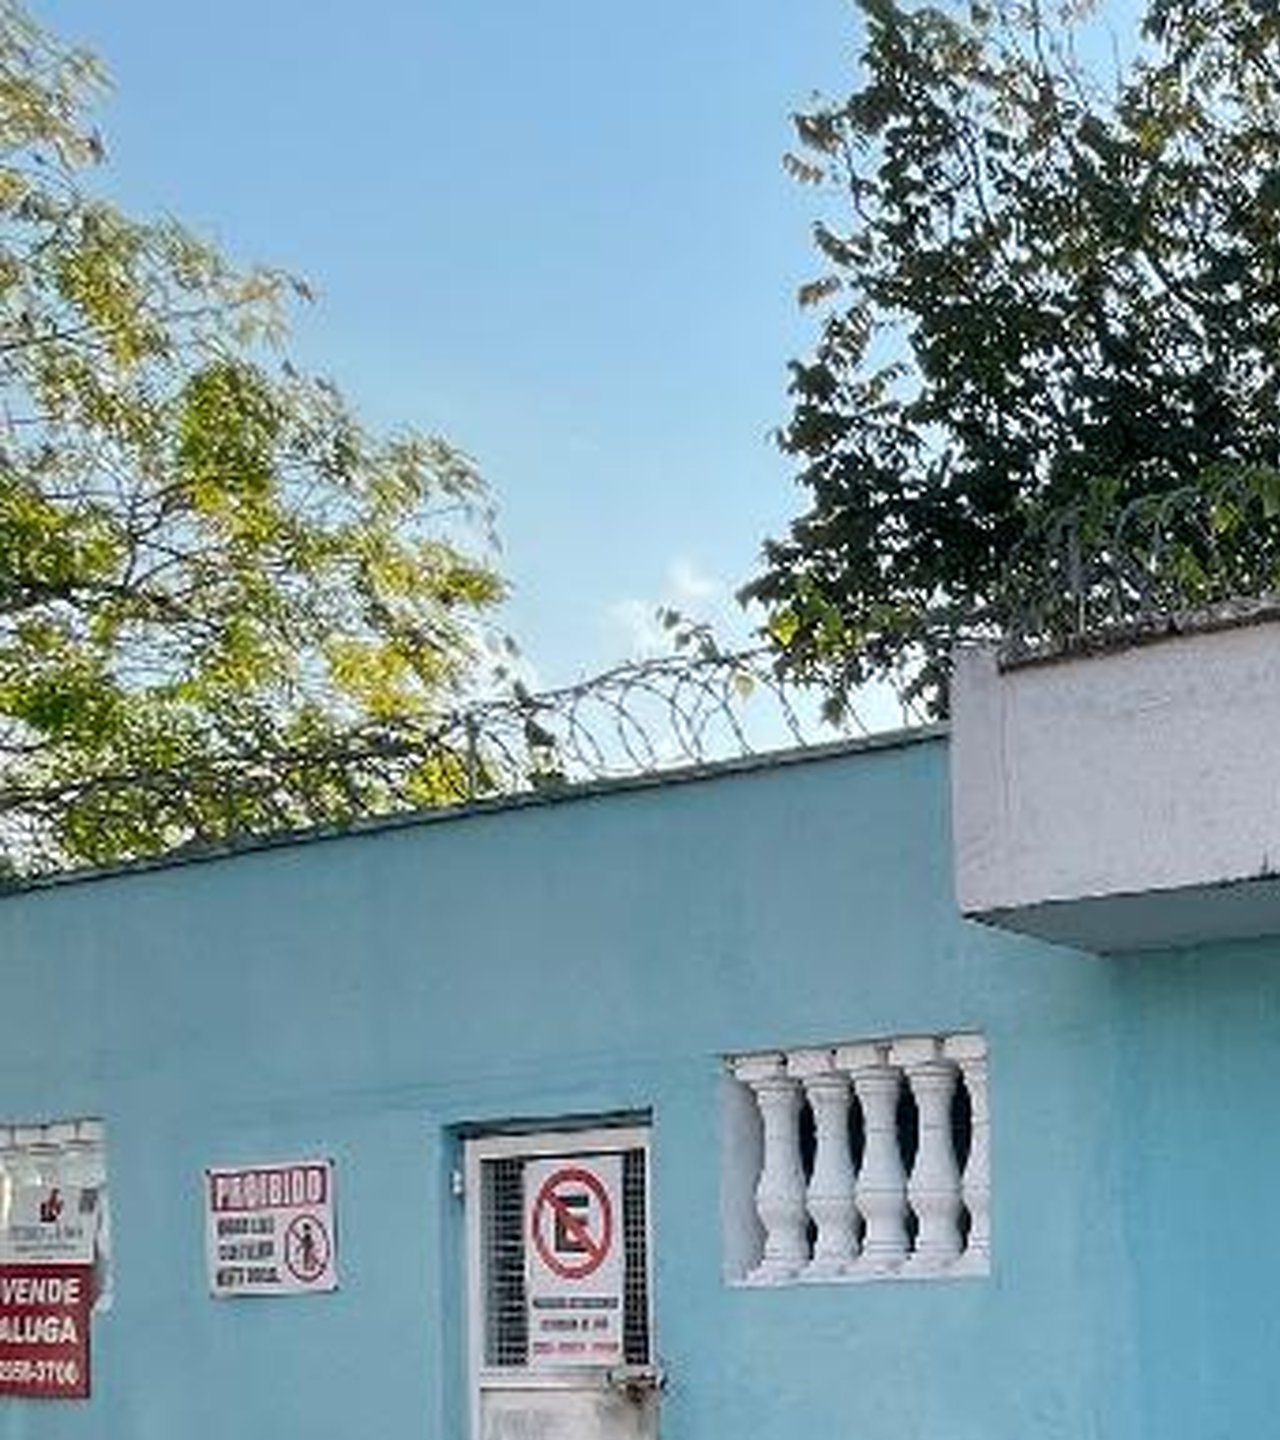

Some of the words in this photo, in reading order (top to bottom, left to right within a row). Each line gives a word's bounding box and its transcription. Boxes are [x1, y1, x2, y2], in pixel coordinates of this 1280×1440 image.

[214, 1168, 326, 1209] PROIBIDO
[2, 1278, 81, 1305] VENDE
[0, 1315, 79, 1343] ALUGA
